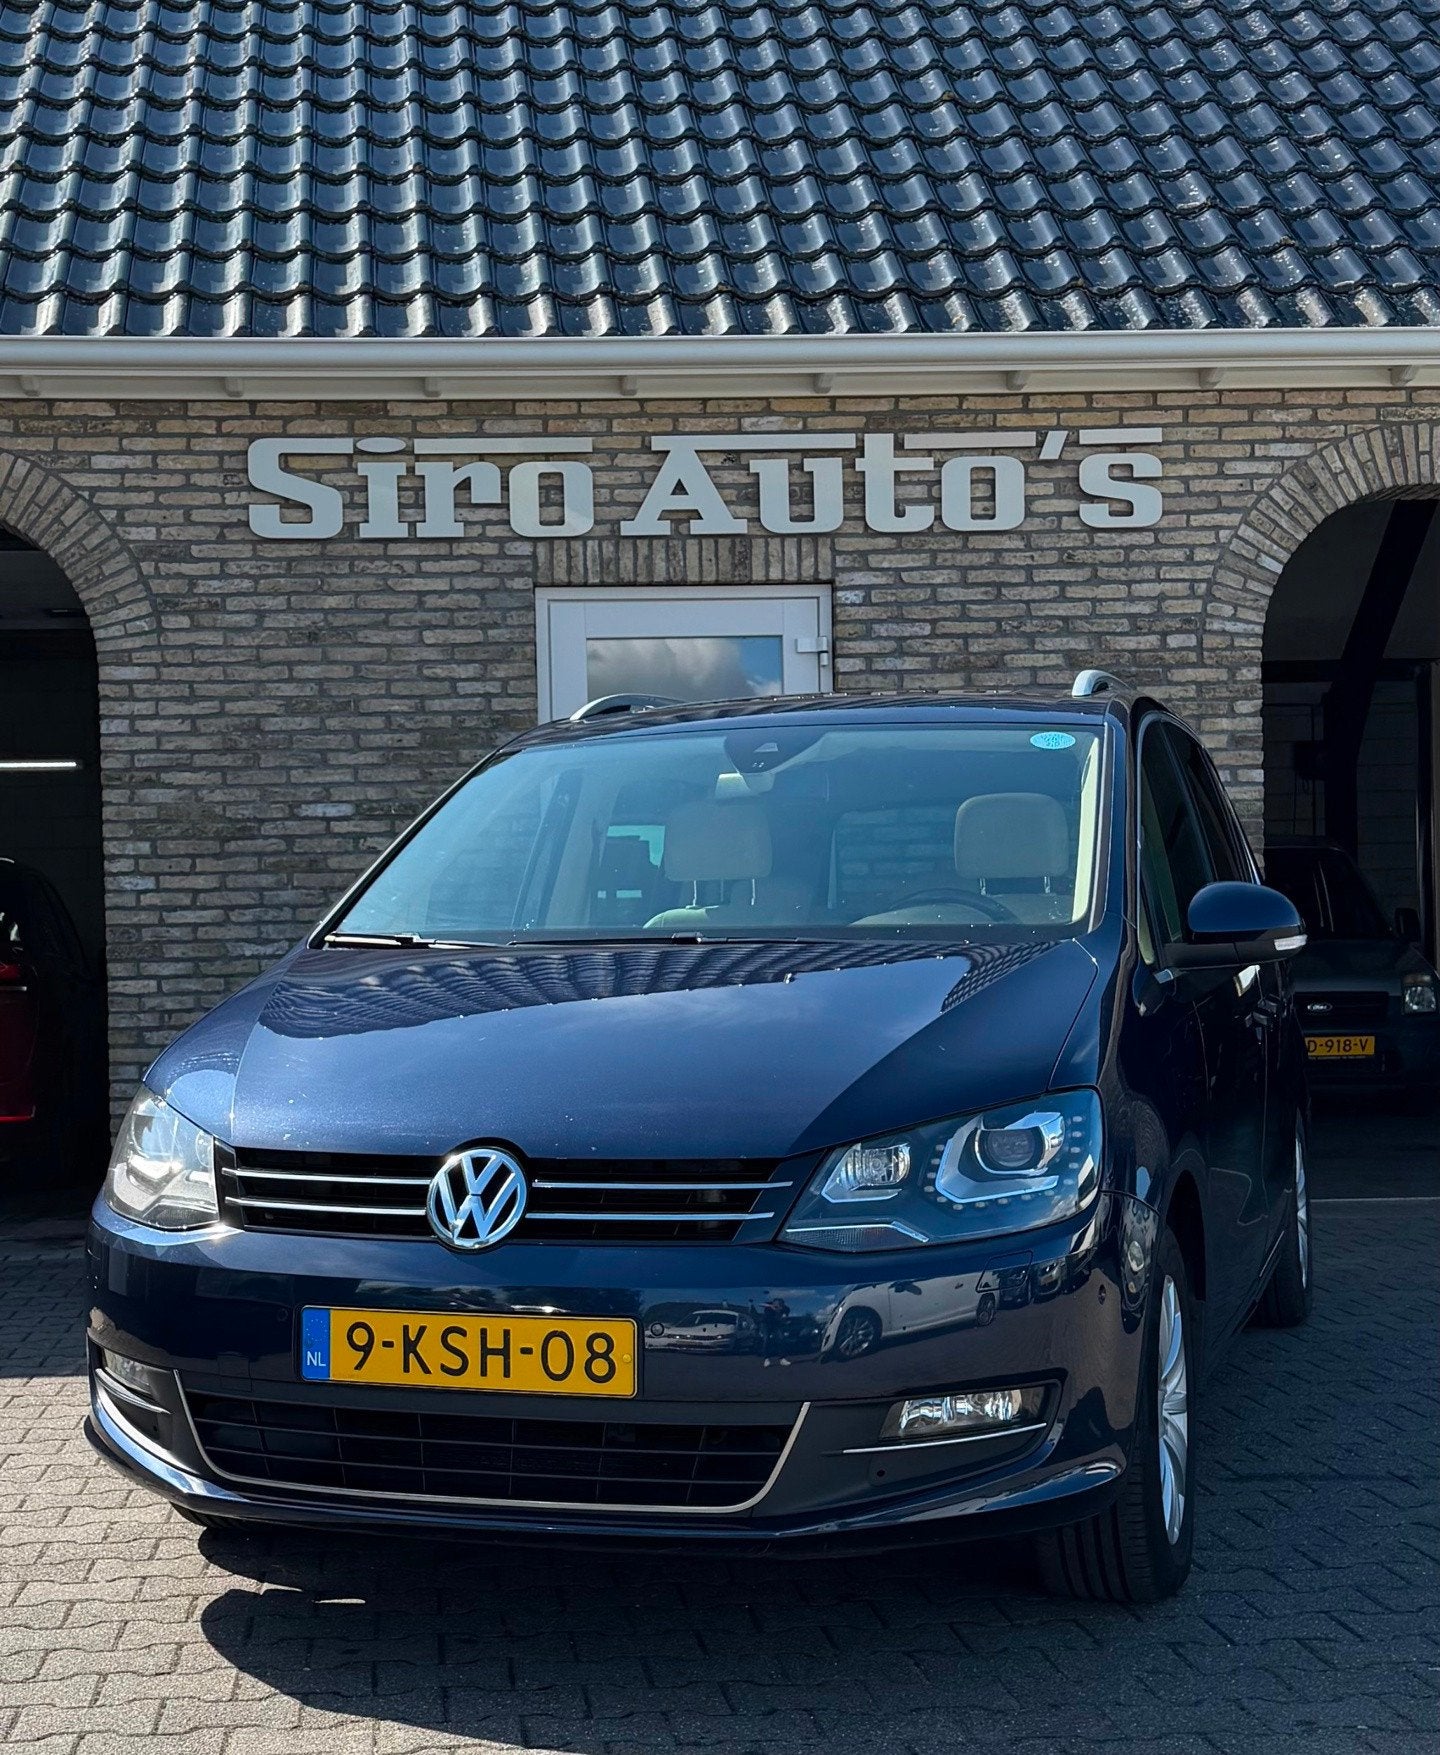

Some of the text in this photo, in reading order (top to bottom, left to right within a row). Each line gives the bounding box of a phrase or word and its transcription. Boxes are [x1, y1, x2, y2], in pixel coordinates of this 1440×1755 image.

[247, 427, 1163, 539] Siro Auto's
[306, 1351, 327, 1367] NL
[346, 1321, 617, 1384] 9-KSH-08
